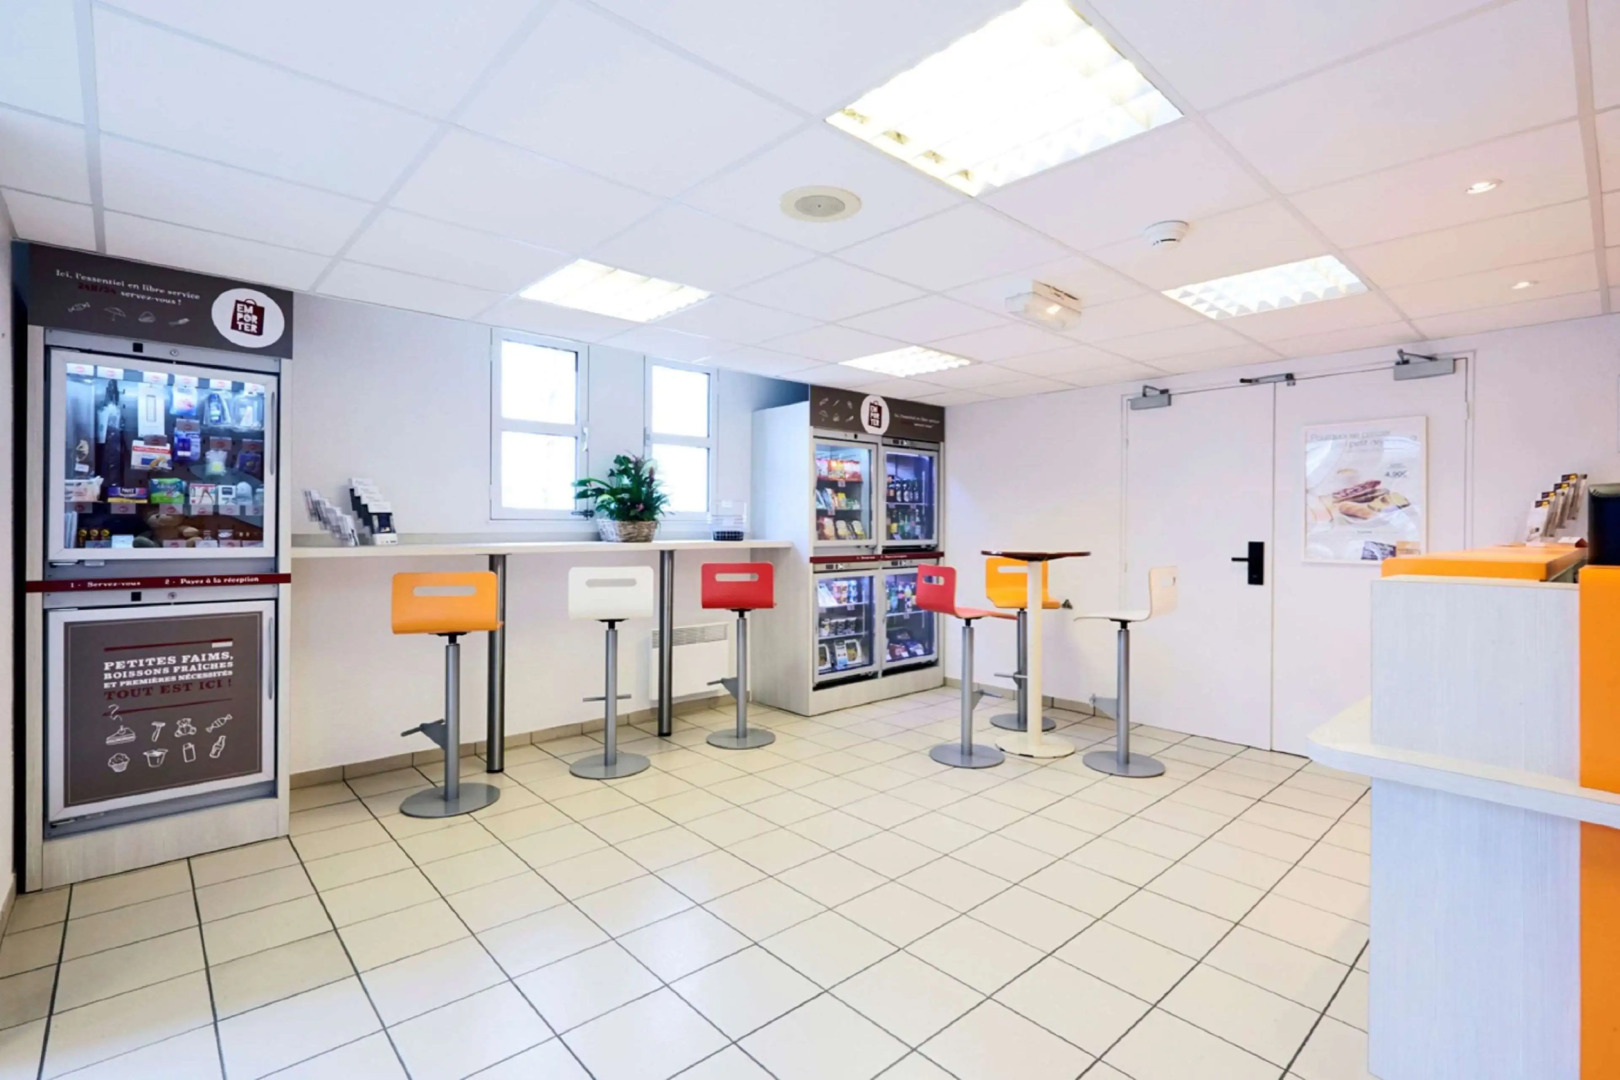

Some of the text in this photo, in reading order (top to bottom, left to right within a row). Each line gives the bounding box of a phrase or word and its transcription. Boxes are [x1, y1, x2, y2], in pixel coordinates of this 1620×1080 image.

[75, 272, 125, 287] l'essentiel
[142, 283, 165, 294] libre
[167, 290, 200, 300] service
[121, 291, 176, 305] servez-vous
[236, 303, 254, 314] EM
[236, 312, 258, 325] POR
[236, 321, 258, 333] TER
[180, 578, 204, 586] Payez
[213, 576, 222, 584] la
[223, 575, 260, 585] réception
[103, 651, 234, 671] PETITES FAIMS,
[103, 661, 234, 680] BOISSONS FRAÎCHES
[103, 669, 234, 689] ET PREMIÈRES NÉCESSITÉS
[104, 678, 232, 701] TOUT EST ICI !
